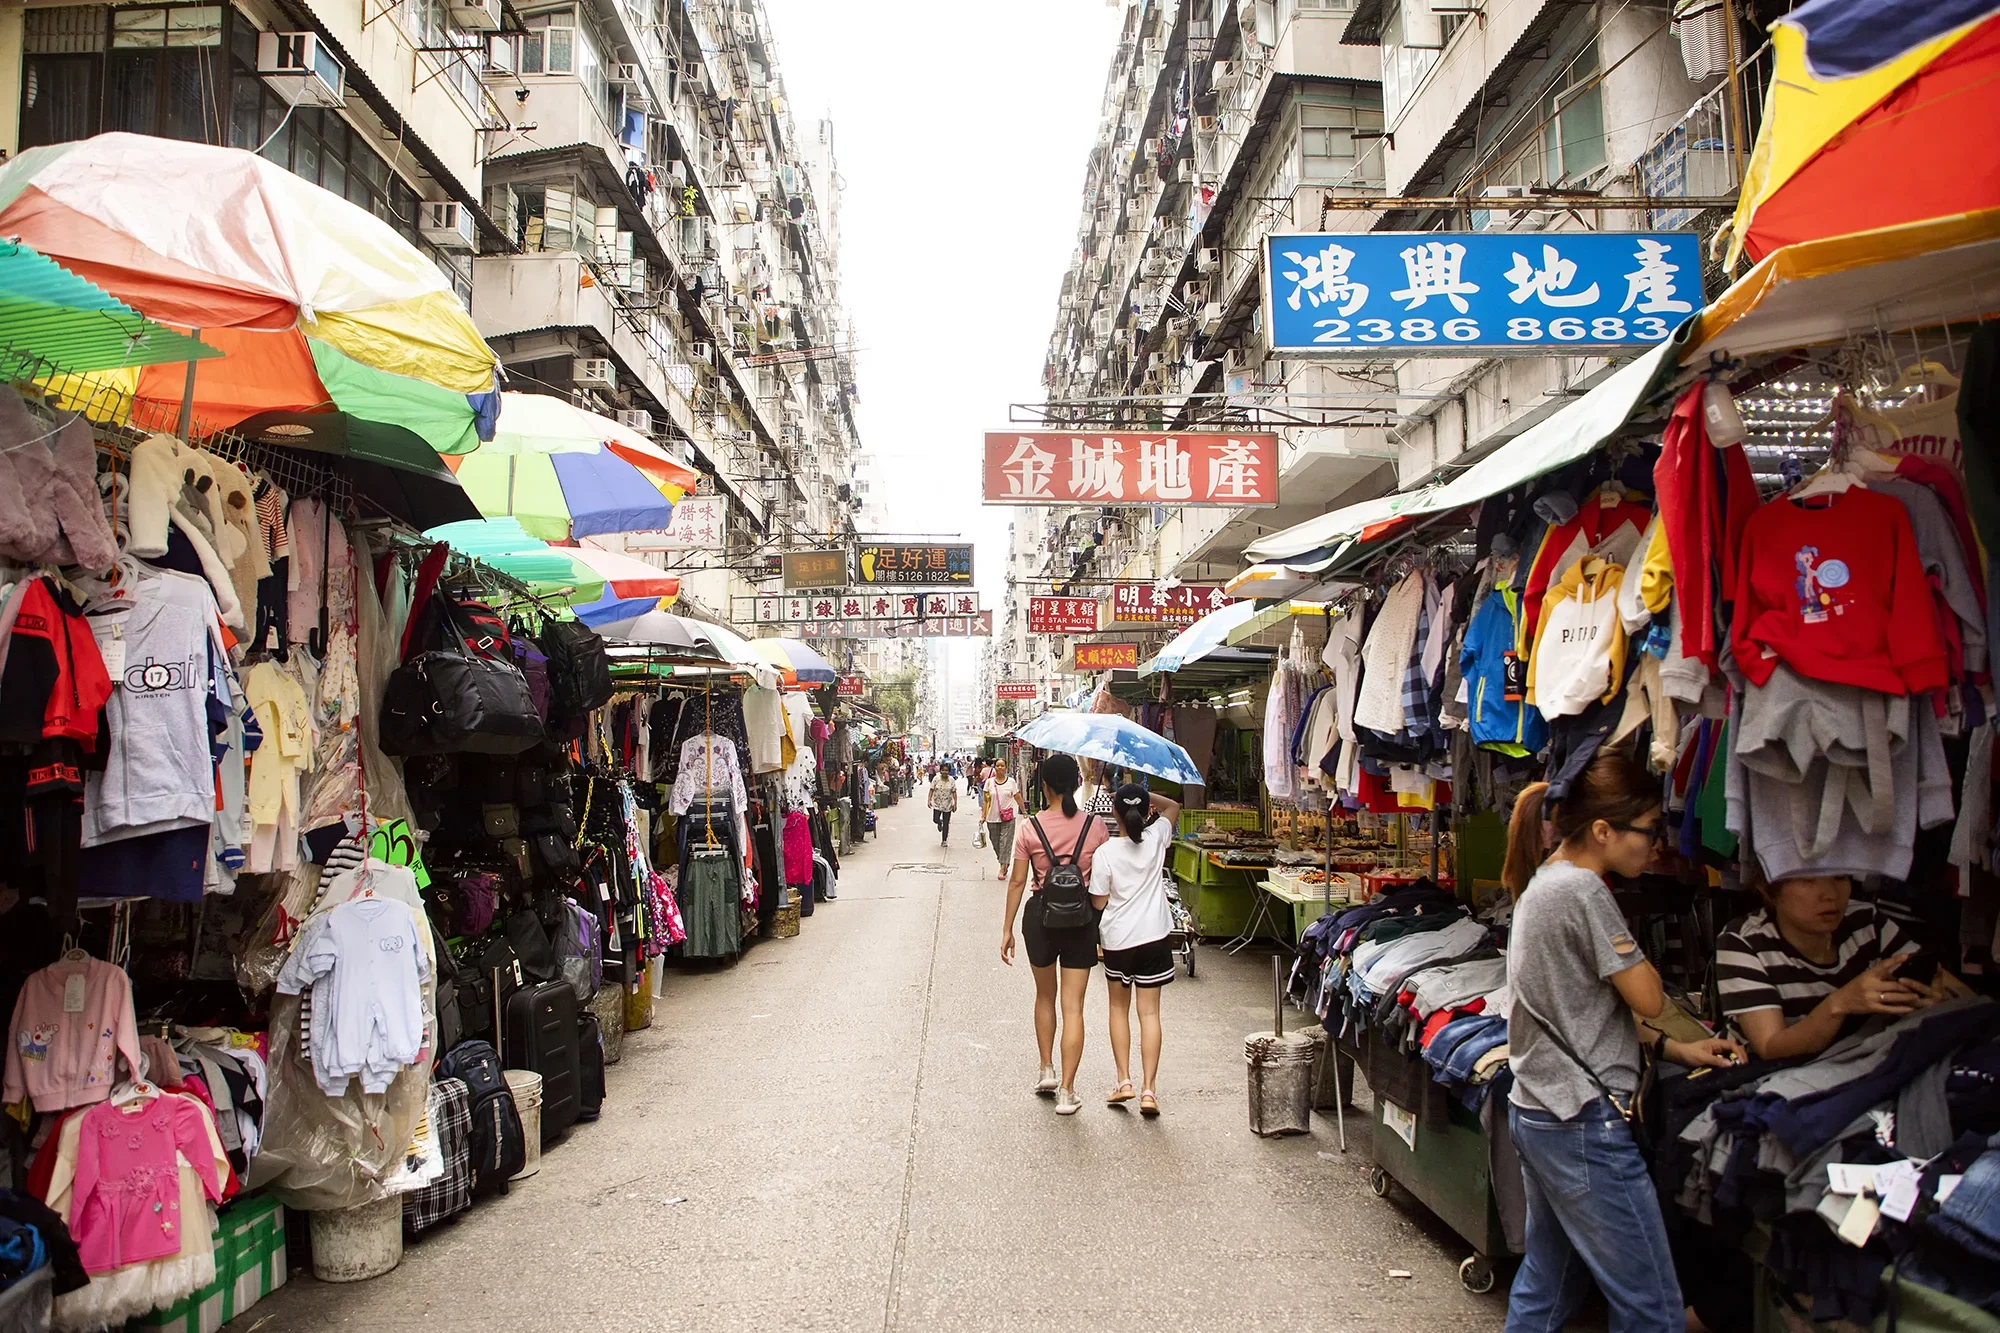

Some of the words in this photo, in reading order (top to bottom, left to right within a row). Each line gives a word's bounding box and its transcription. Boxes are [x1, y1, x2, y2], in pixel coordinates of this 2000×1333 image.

[1282, 239, 1692, 317] 鴻興地產
[1312, 319, 1481, 342] 2386
[1507, 317, 1669, 341] 8683
[1000, 436, 1261, 498] 金城地產
[679, 523, 716, 543] 海味
[876, 547, 947, 570] 足好運
[948, 549, 970, 560] 穴位
[798, 558, 837, 572] 足好運
[948, 561, 970, 572] 推拿
[898, 571, 923, 582] 5126
[926, 571, 949, 582] 1822
[1119, 586, 1229, 609] 明發小食
[1071, 617, 1095, 625] HOTEL
[150, 671, 163, 683] 17
